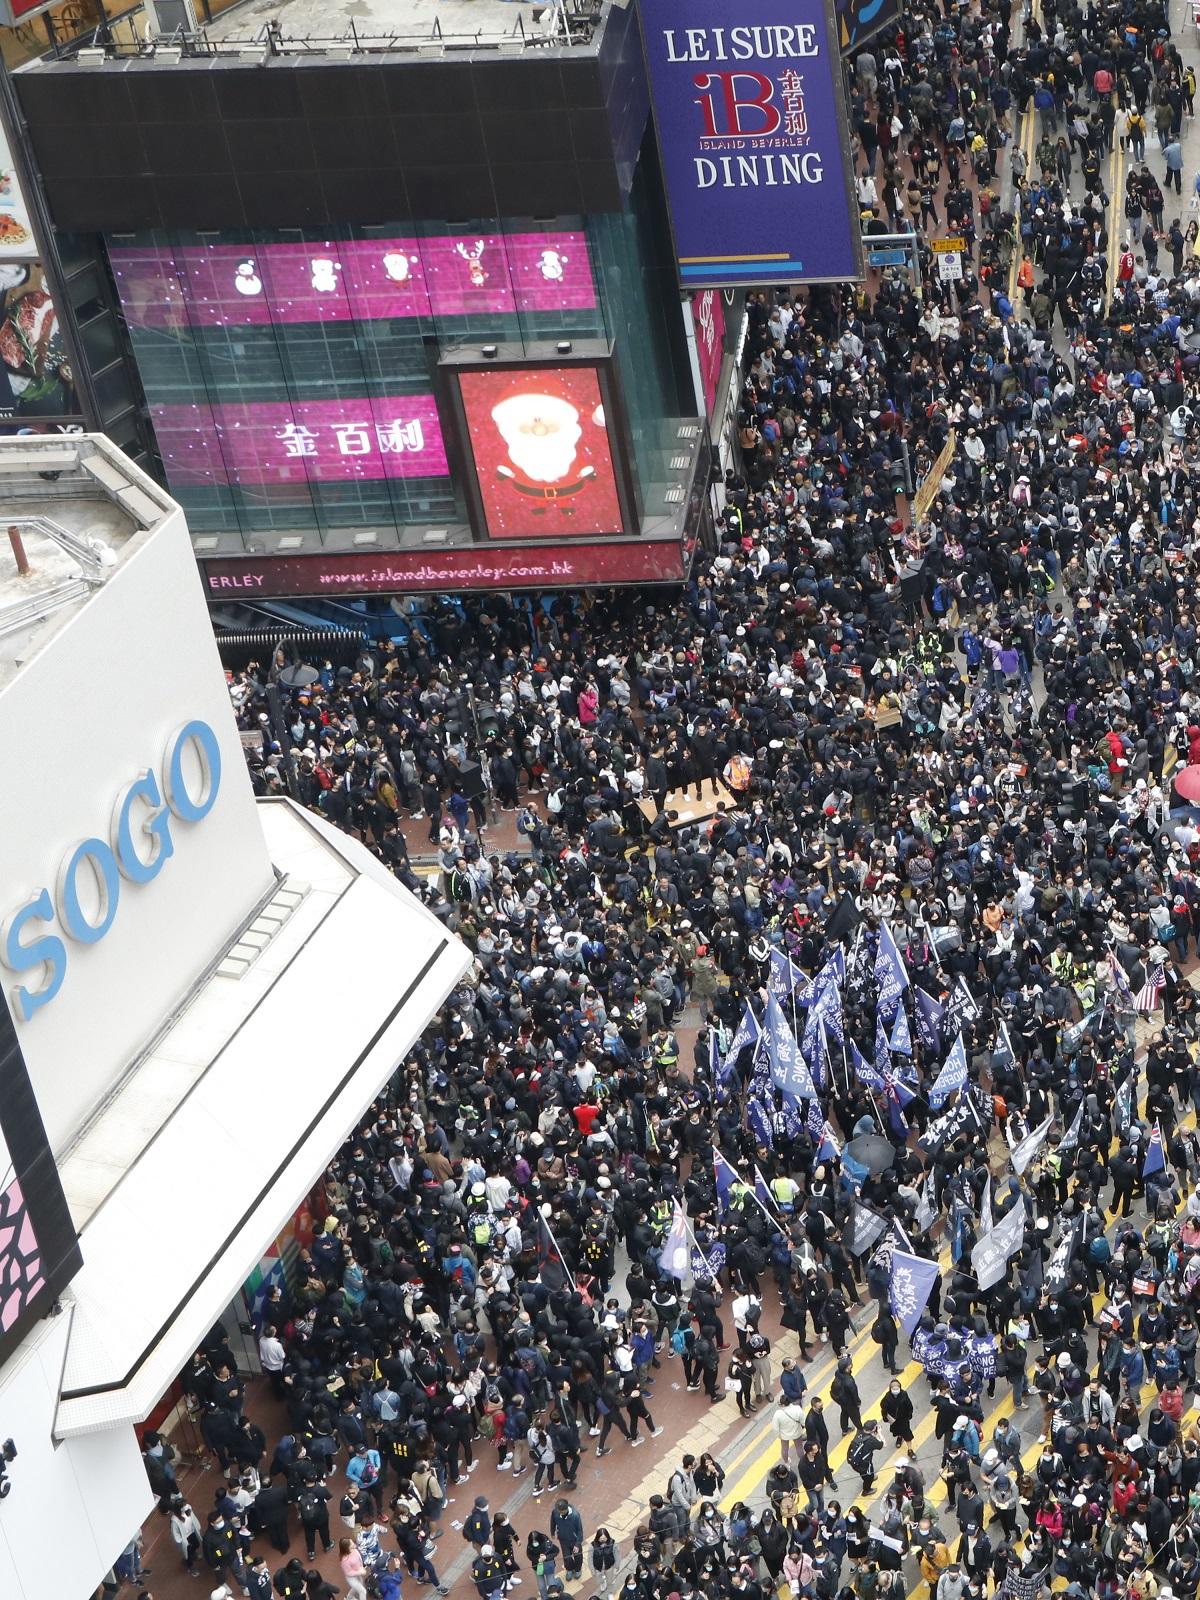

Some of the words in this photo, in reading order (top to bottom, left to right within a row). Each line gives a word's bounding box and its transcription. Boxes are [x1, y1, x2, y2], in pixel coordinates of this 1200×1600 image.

[663, 24, 819, 62] LEISURE
[699, 139, 745, 150] ISLAND
[751, 137, 811, 149] BEVERLEY
[694, 153, 823, 188] DINING
[319, 561, 573, 586] www.islandbeverley.com.hk
[0, 718, 222, 1022] SOGO
